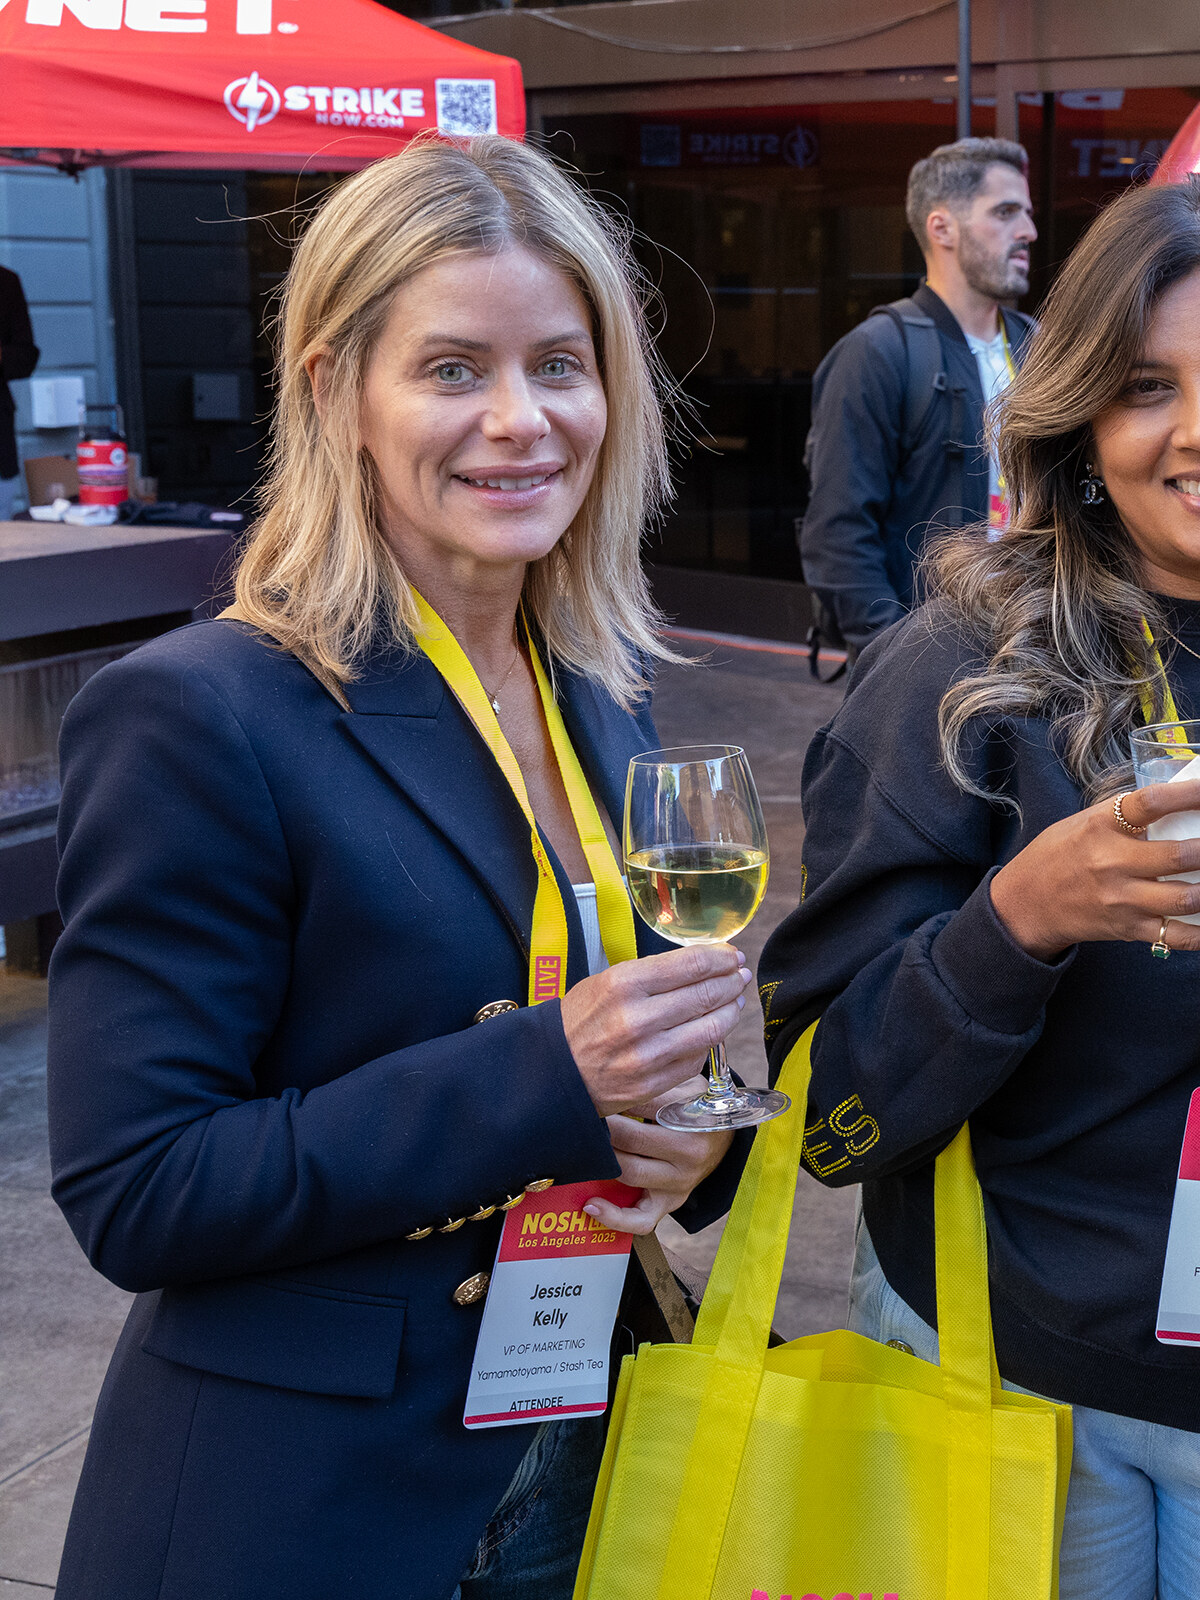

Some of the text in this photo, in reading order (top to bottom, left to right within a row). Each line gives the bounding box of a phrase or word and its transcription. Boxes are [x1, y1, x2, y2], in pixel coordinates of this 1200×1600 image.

[284, 86, 425, 117] STRIKE
[315, 113, 405, 128] NOW.COM
[536, 958, 561, 1000] LIVE
[518, 1232, 616, 1248] Los Angeles 2025
[530, 1282, 583, 1300] Jessica
[532, 1308, 569, 1329] Kelly
[503, 1338, 586, 1356] VP OF MARKETING
[477, 1358, 604, 1381] Yamamotoyama / Stash Tea
[509, 1396, 564, 1412] ATTENDEE
